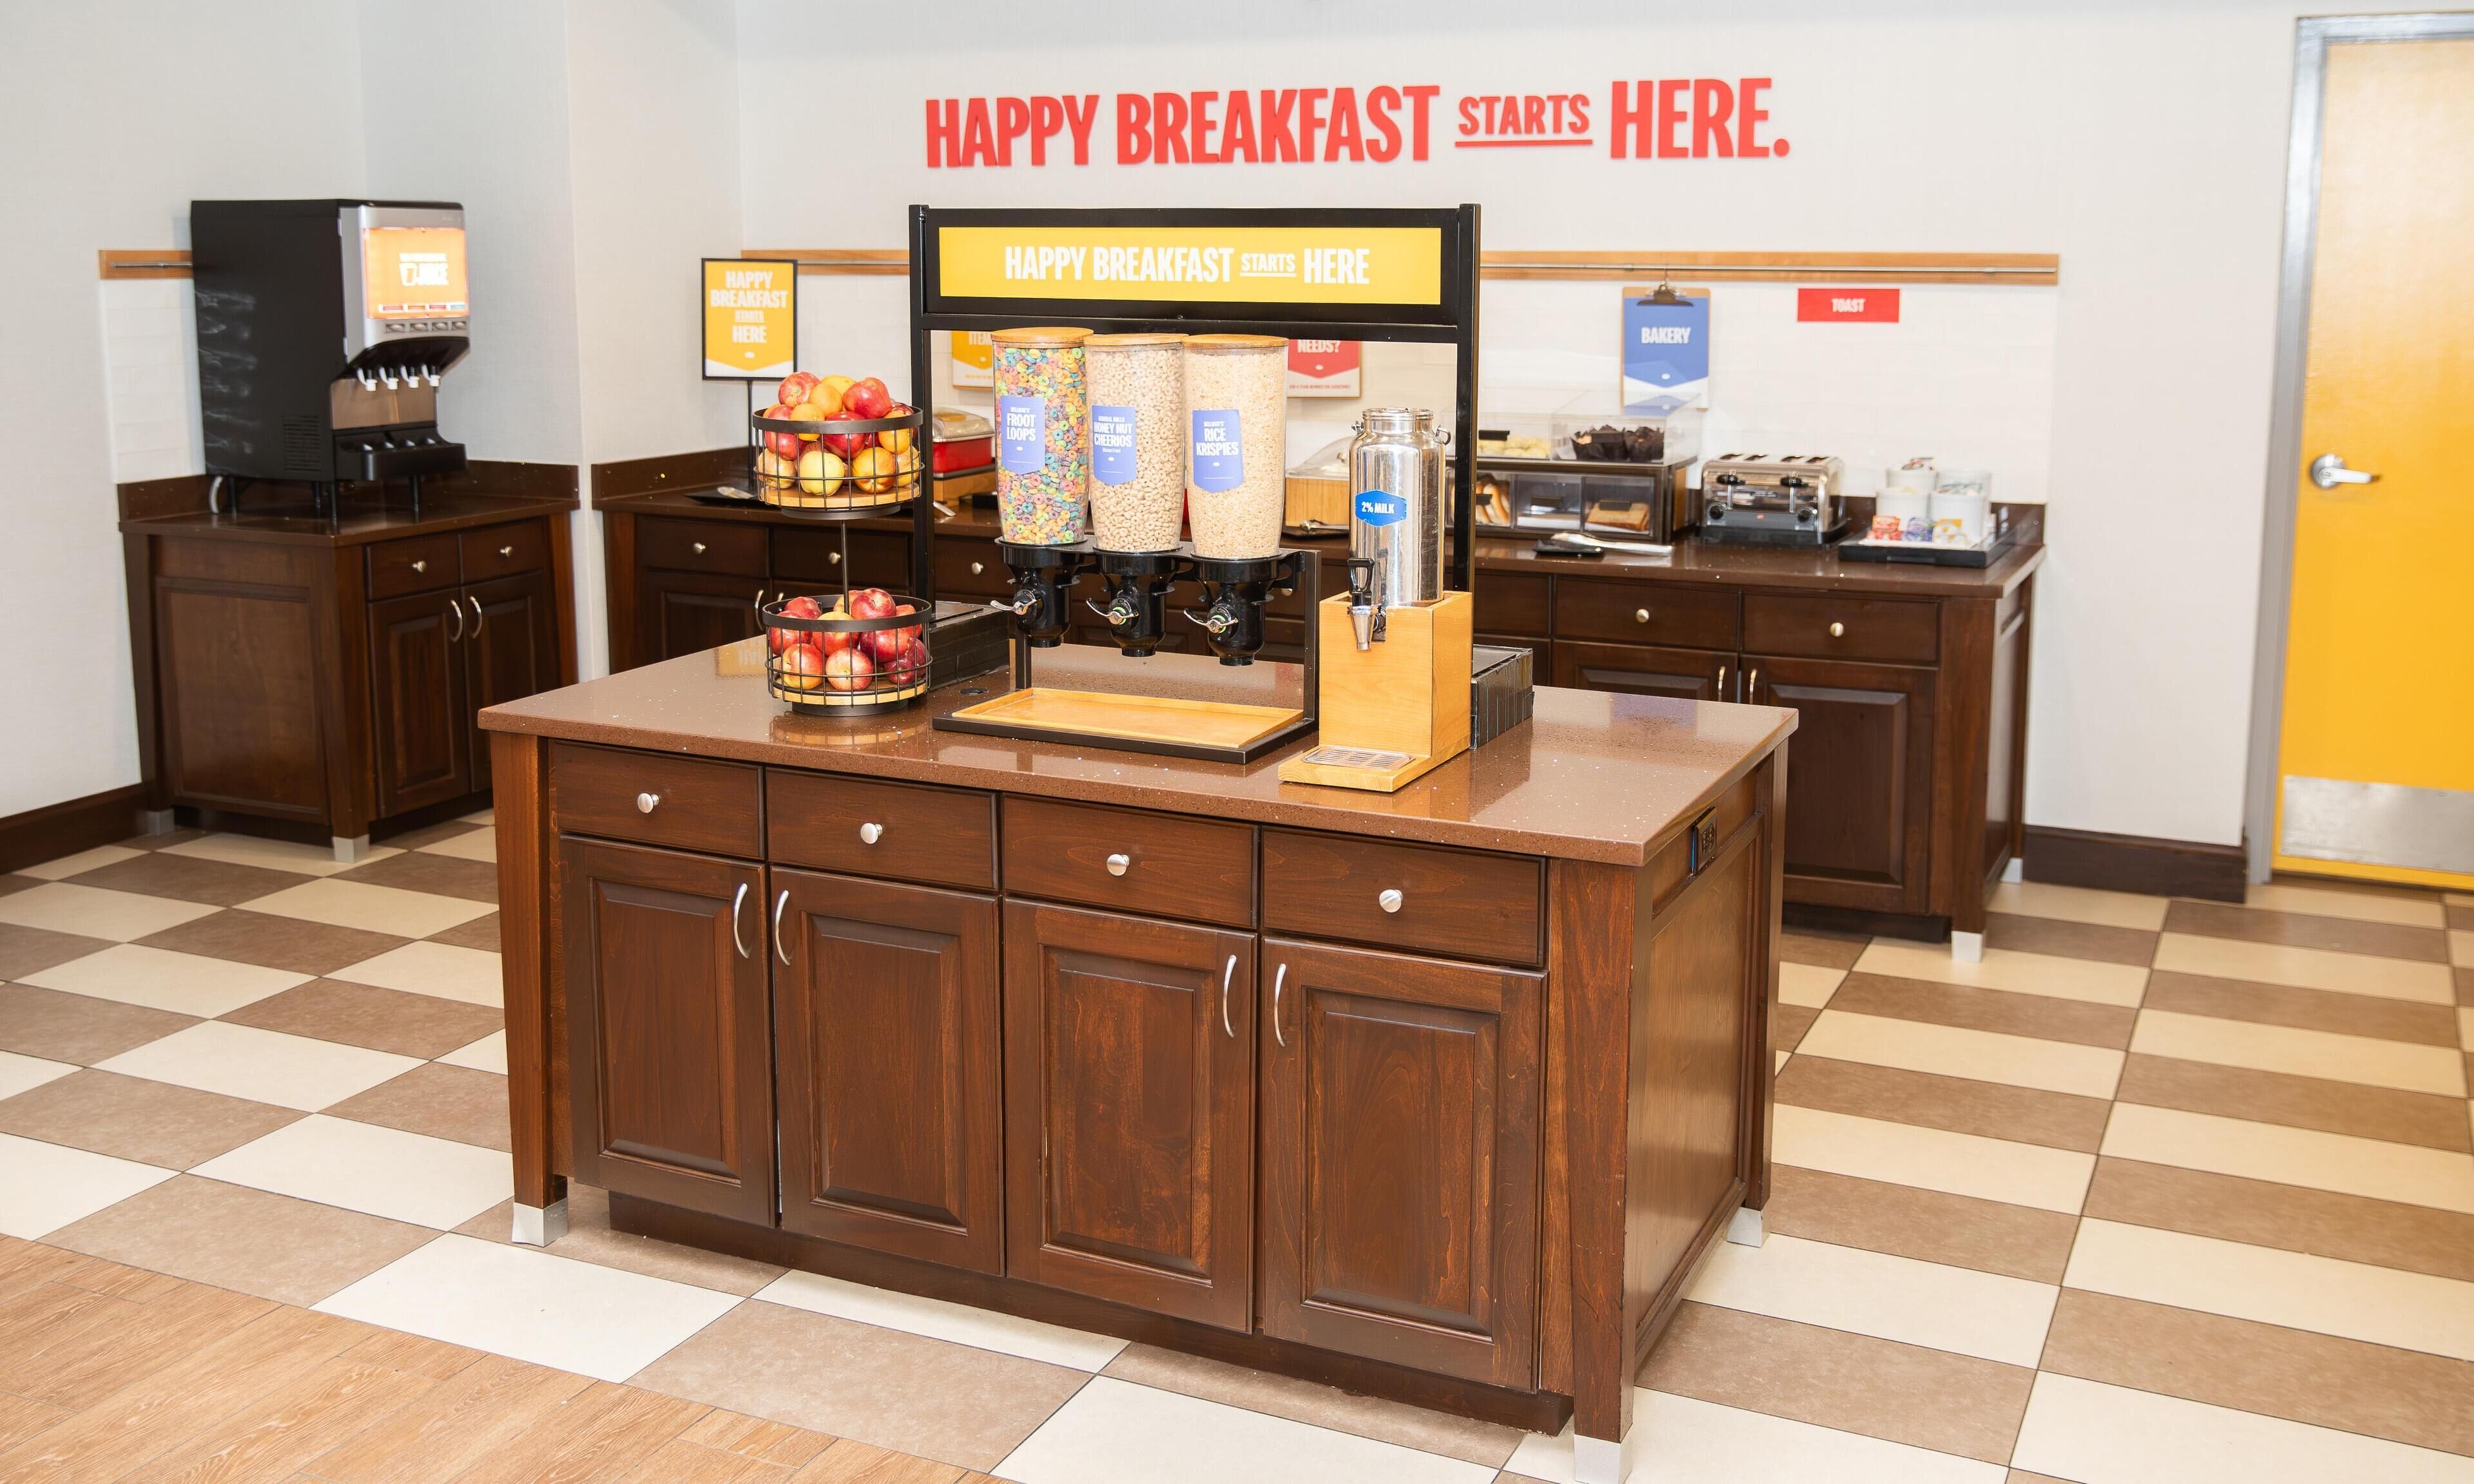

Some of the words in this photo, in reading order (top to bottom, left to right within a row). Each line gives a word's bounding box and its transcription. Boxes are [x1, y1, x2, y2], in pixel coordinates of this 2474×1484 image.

[926, 95, 1099, 167] HAPPY
[1117, 86, 1440, 166] BREAKFAST
[1459, 94, 1590, 135] STARTS
[1611, 78, 1790, 158] HERE.
[1005, 246, 1086, 280] HAPPY
[1093, 247, 1234, 283] BREAKFAST
[1241, 253, 1296, 272] STARTS
[1303, 248, 1370, 284] HERE
[725, 271, 773, 289] HAPPY
[711, 289, 788, 309] BREAKFAST
[1832, 298, 1866, 313] TOAST
[732, 325, 767, 343] HERE
[1641, 327, 1691, 344] BAKERY
[1297, 339, 1341, 354] NEEDS?
[1006, 412, 1036, 427] FROOT
[1006, 426, 1036, 441] LOOPS
[1094, 422, 1115, 433] HONEY
[1116, 423, 1133, 435] NUT
[1204, 427, 1226, 442] RICE
[1094, 433, 1133, 448] CHEERIOS
[1196, 442, 1239, 456] KRISPIES
[1361, 501, 1374, 513] 2%
[1374, 502, 1395, 514] MILK
